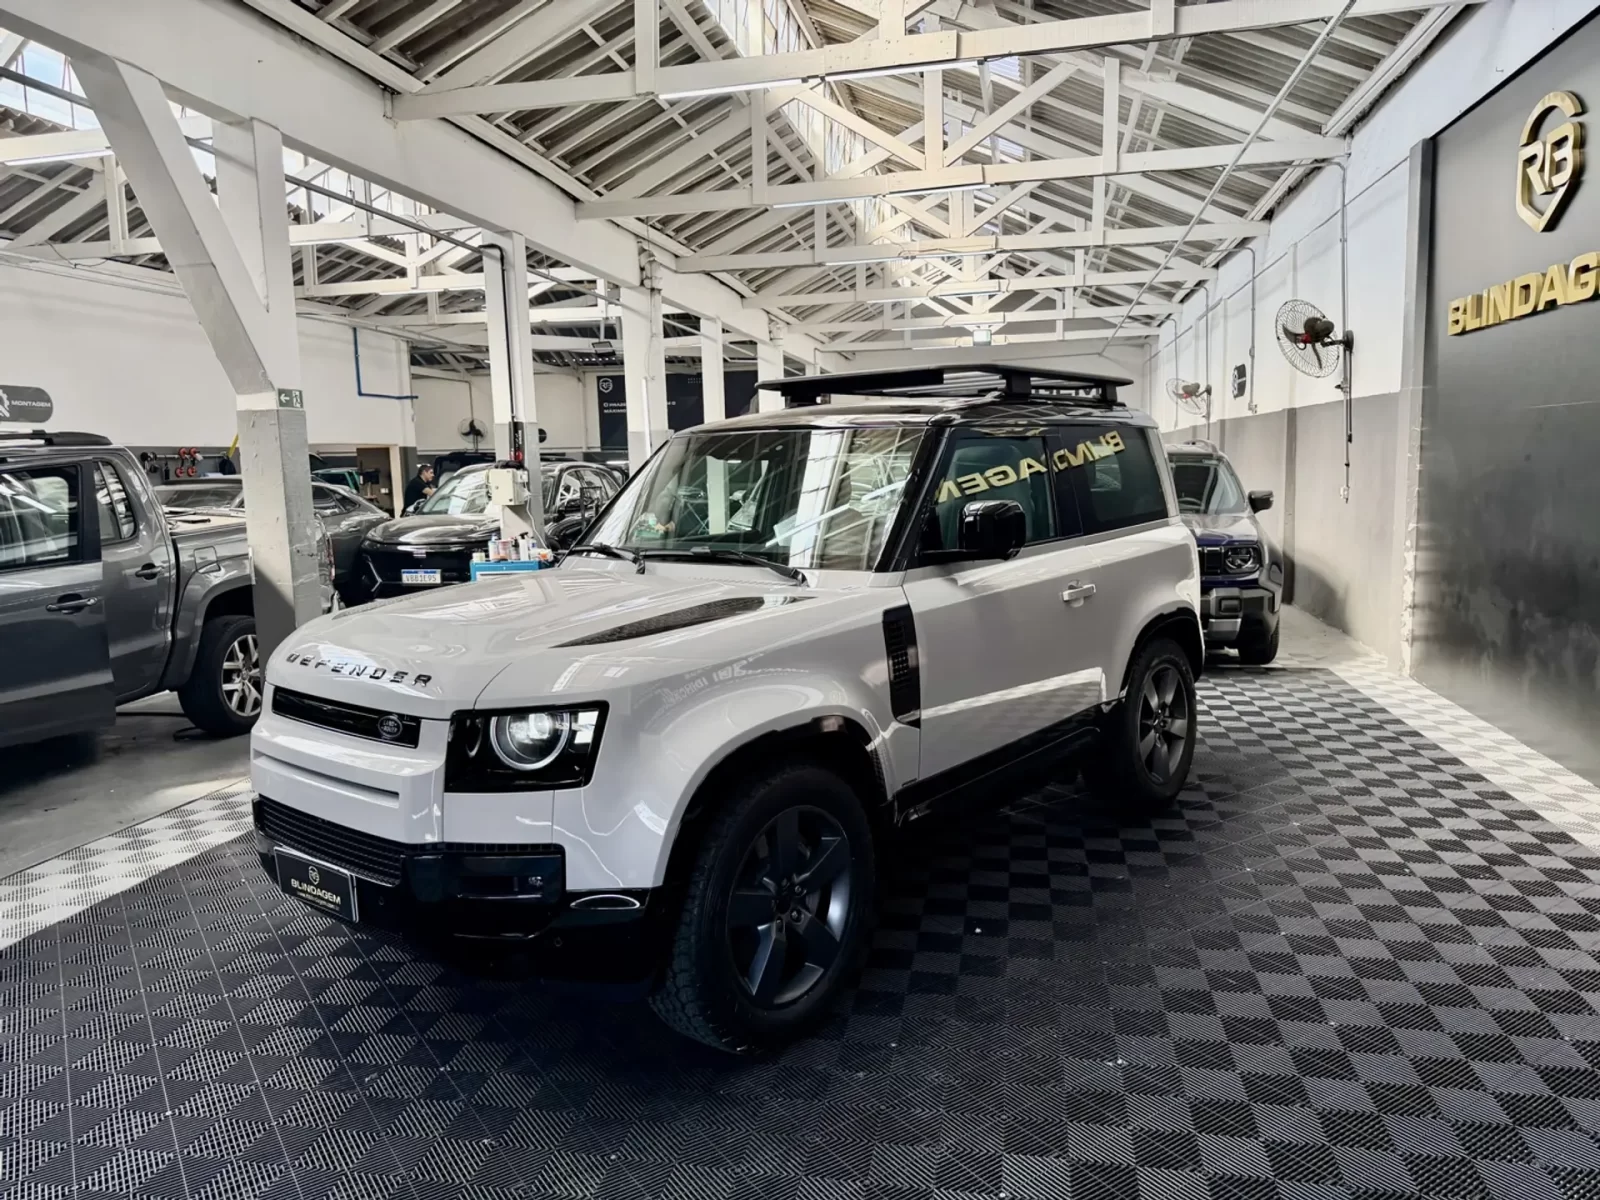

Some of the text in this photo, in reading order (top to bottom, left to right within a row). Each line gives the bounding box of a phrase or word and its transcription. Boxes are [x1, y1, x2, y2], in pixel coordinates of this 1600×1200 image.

[1447, 251, 1600, 336] BLINDAG
[285, 652, 432, 687] DEFENDER
[291, 878, 341, 905] BLINDAGEM
